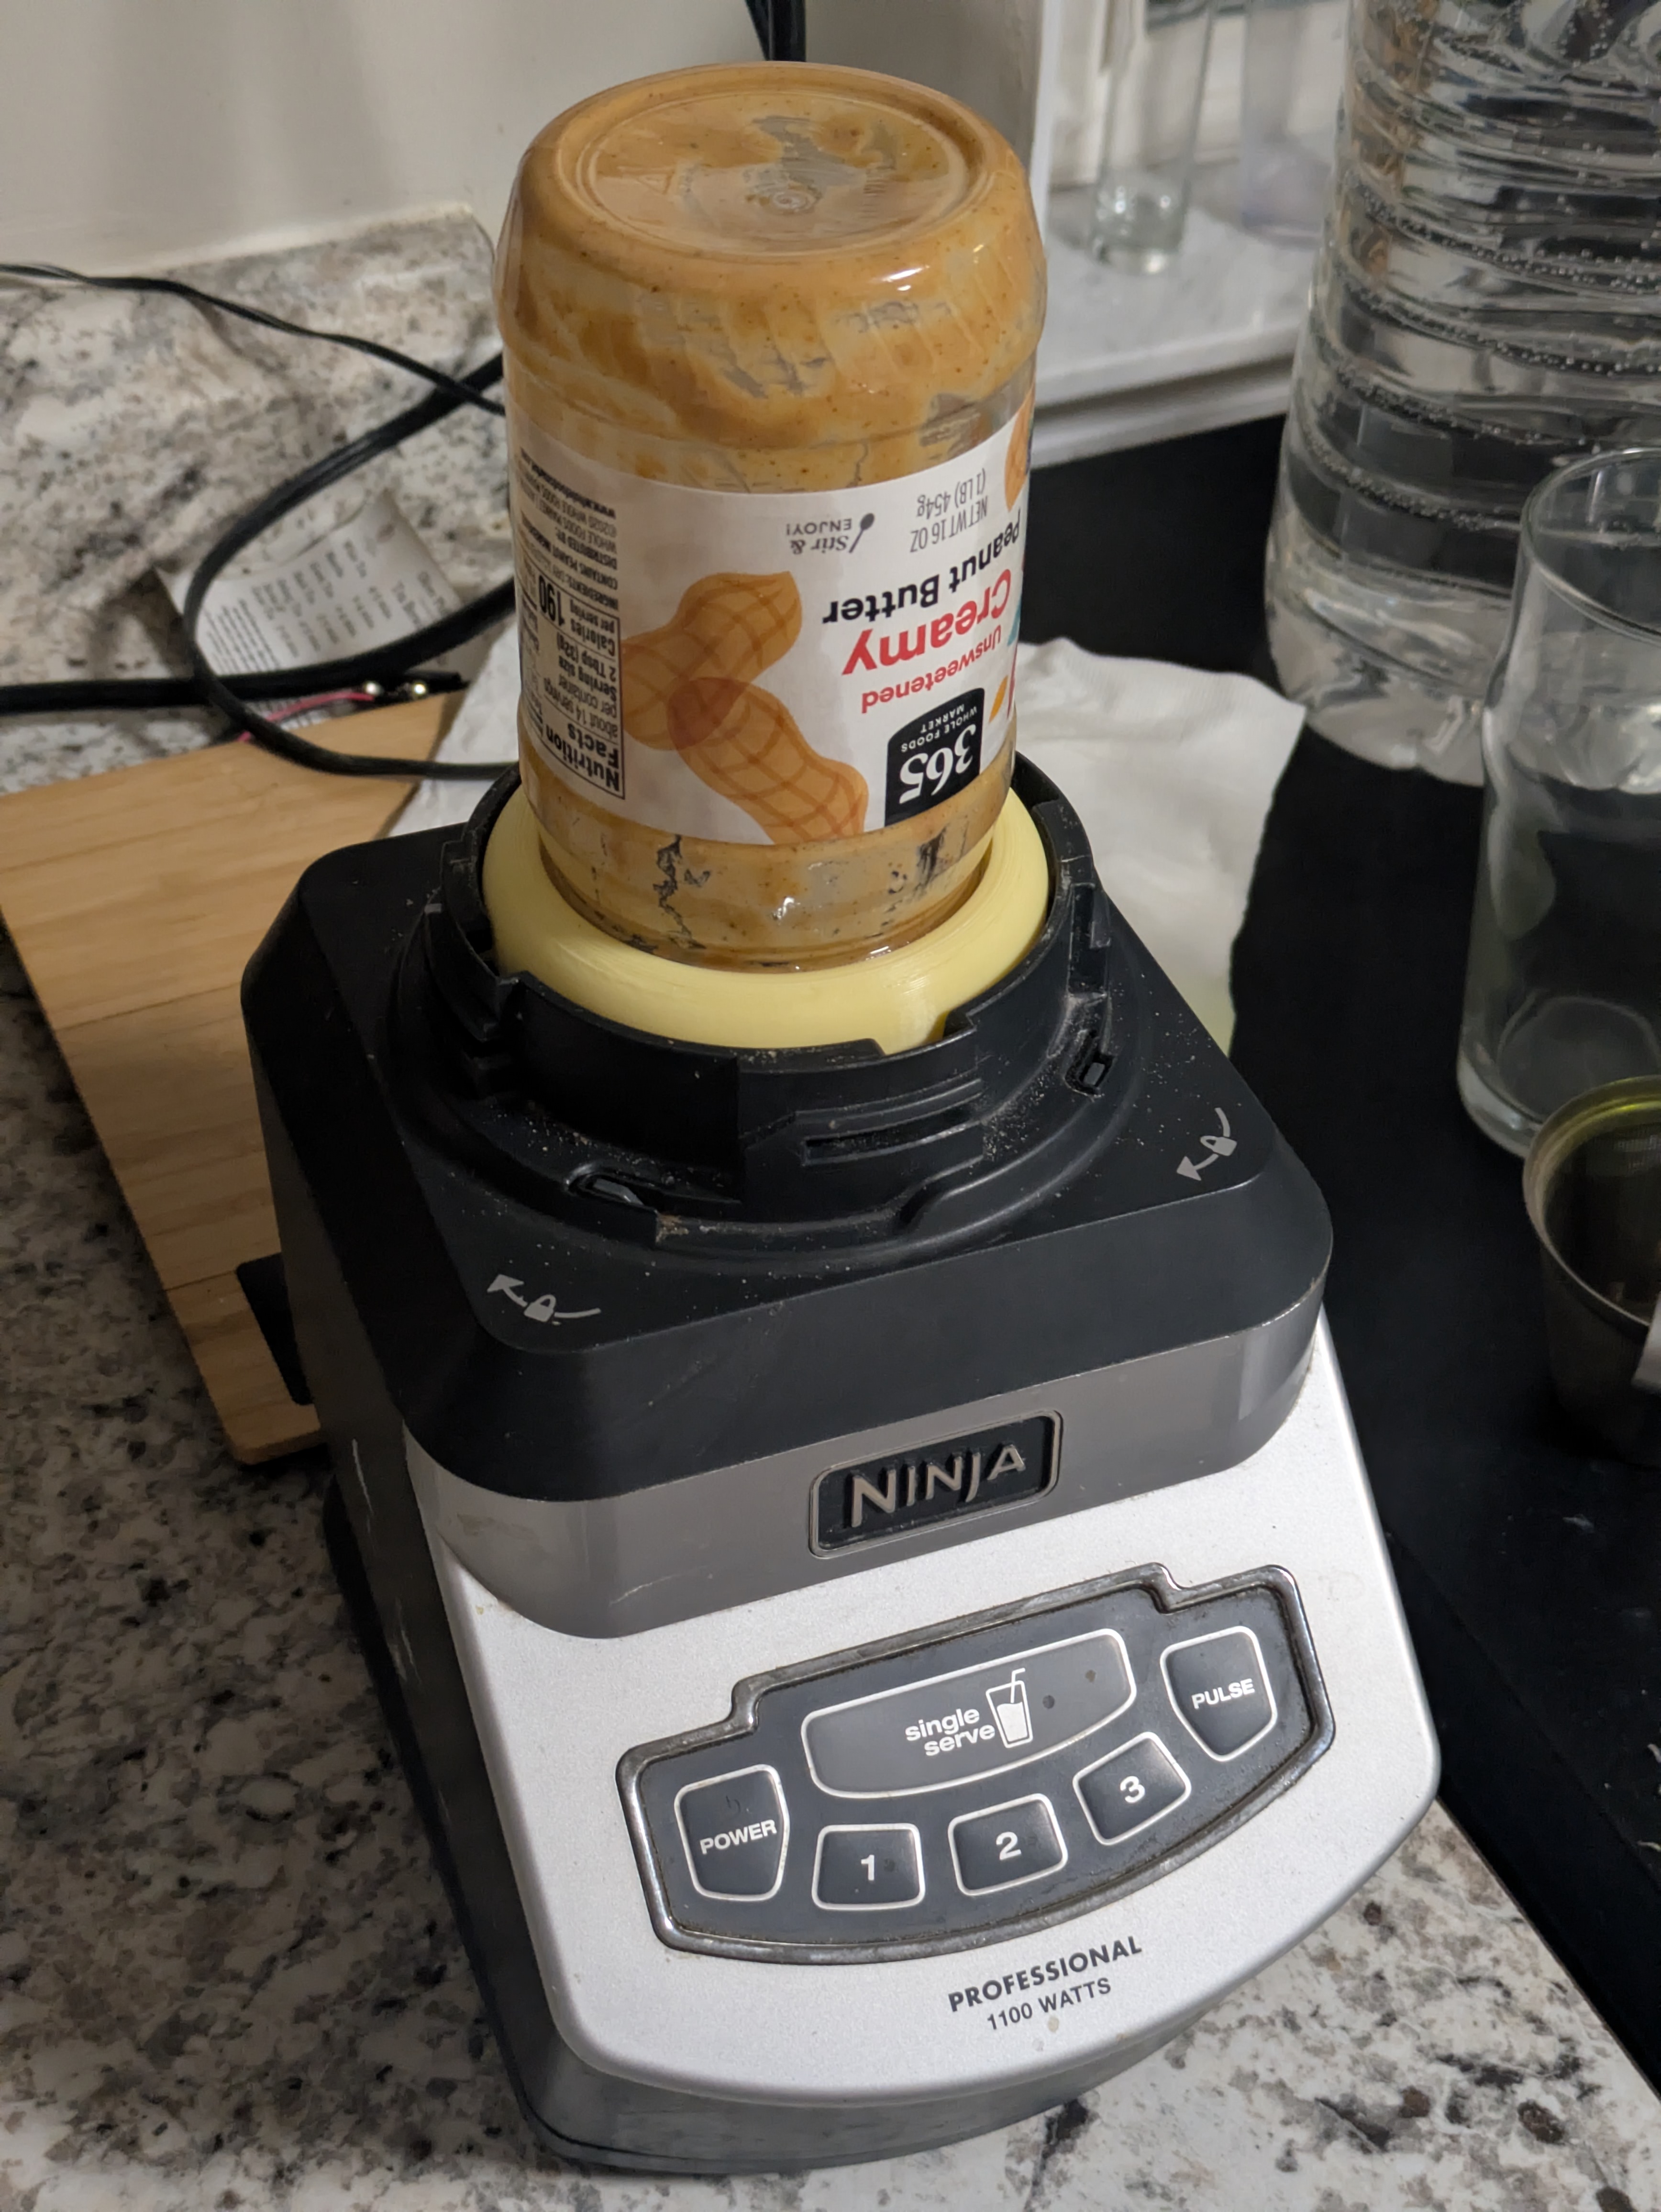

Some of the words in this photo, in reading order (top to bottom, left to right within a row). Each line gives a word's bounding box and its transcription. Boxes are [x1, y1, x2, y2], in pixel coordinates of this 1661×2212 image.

[917, 492, 951, 519] 454g
[955, 478, 974, 509] LB)
[949, 509, 968, 538] WT
[967, 496, 987, 523] NET
[786, 518, 852, 536] ENJOY!
[910, 529, 928, 553] OZ
[932, 520, 946, 544] 16
[791, 539, 805, 554] &
[811, 536, 849, 553] Stir
[949, 507, 1021, 592] Peanut
[539, 575, 565, 626] 190
[822, 574, 940, 623] Butter
[600, 619, 615, 634] per
[842, 569, 1011, 675] Creamy
[570, 618, 615, 657] Calories
[559, 655, 575, 677] size
[582, 651, 606, 678] Tbsp
[609, 666, 616, 682] 2
[862, 625, 1001, 713] Unsweetened
[559, 673, 598, 709] container
[578, 666, 617, 702] Serving
[576, 705, 587, 725] 14
[601, 700, 617, 718] per
[920, 704, 965, 733] MARKET
[944, 706, 977, 734] WHOLE
[589, 712, 618, 739] about
[568, 723, 619, 769] Facts
[901, 731, 940, 752] FOODS
[546, 724, 620, 791] Nutrition
[899, 723, 976, 804] 365
[851, 1444, 1025, 1527] NINJA
[1192, 1678, 1256, 1710] PULSE
[905, 1707, 980, 1742] single
[924, 1724, 996, 1757] serve
[1119, 1776, 1146, 1804] 3
[700, 1819, 777, 1855] POWER
[995, 1831, 1022, 1861] 2
[861, 1854, 875, 1881] 1
[948, 1936, 1142, 2012] PROFESSIONAL
[987, 2002, 1033, 2030] 1100
[1038, 1977, 1111, 2013] WATTS
